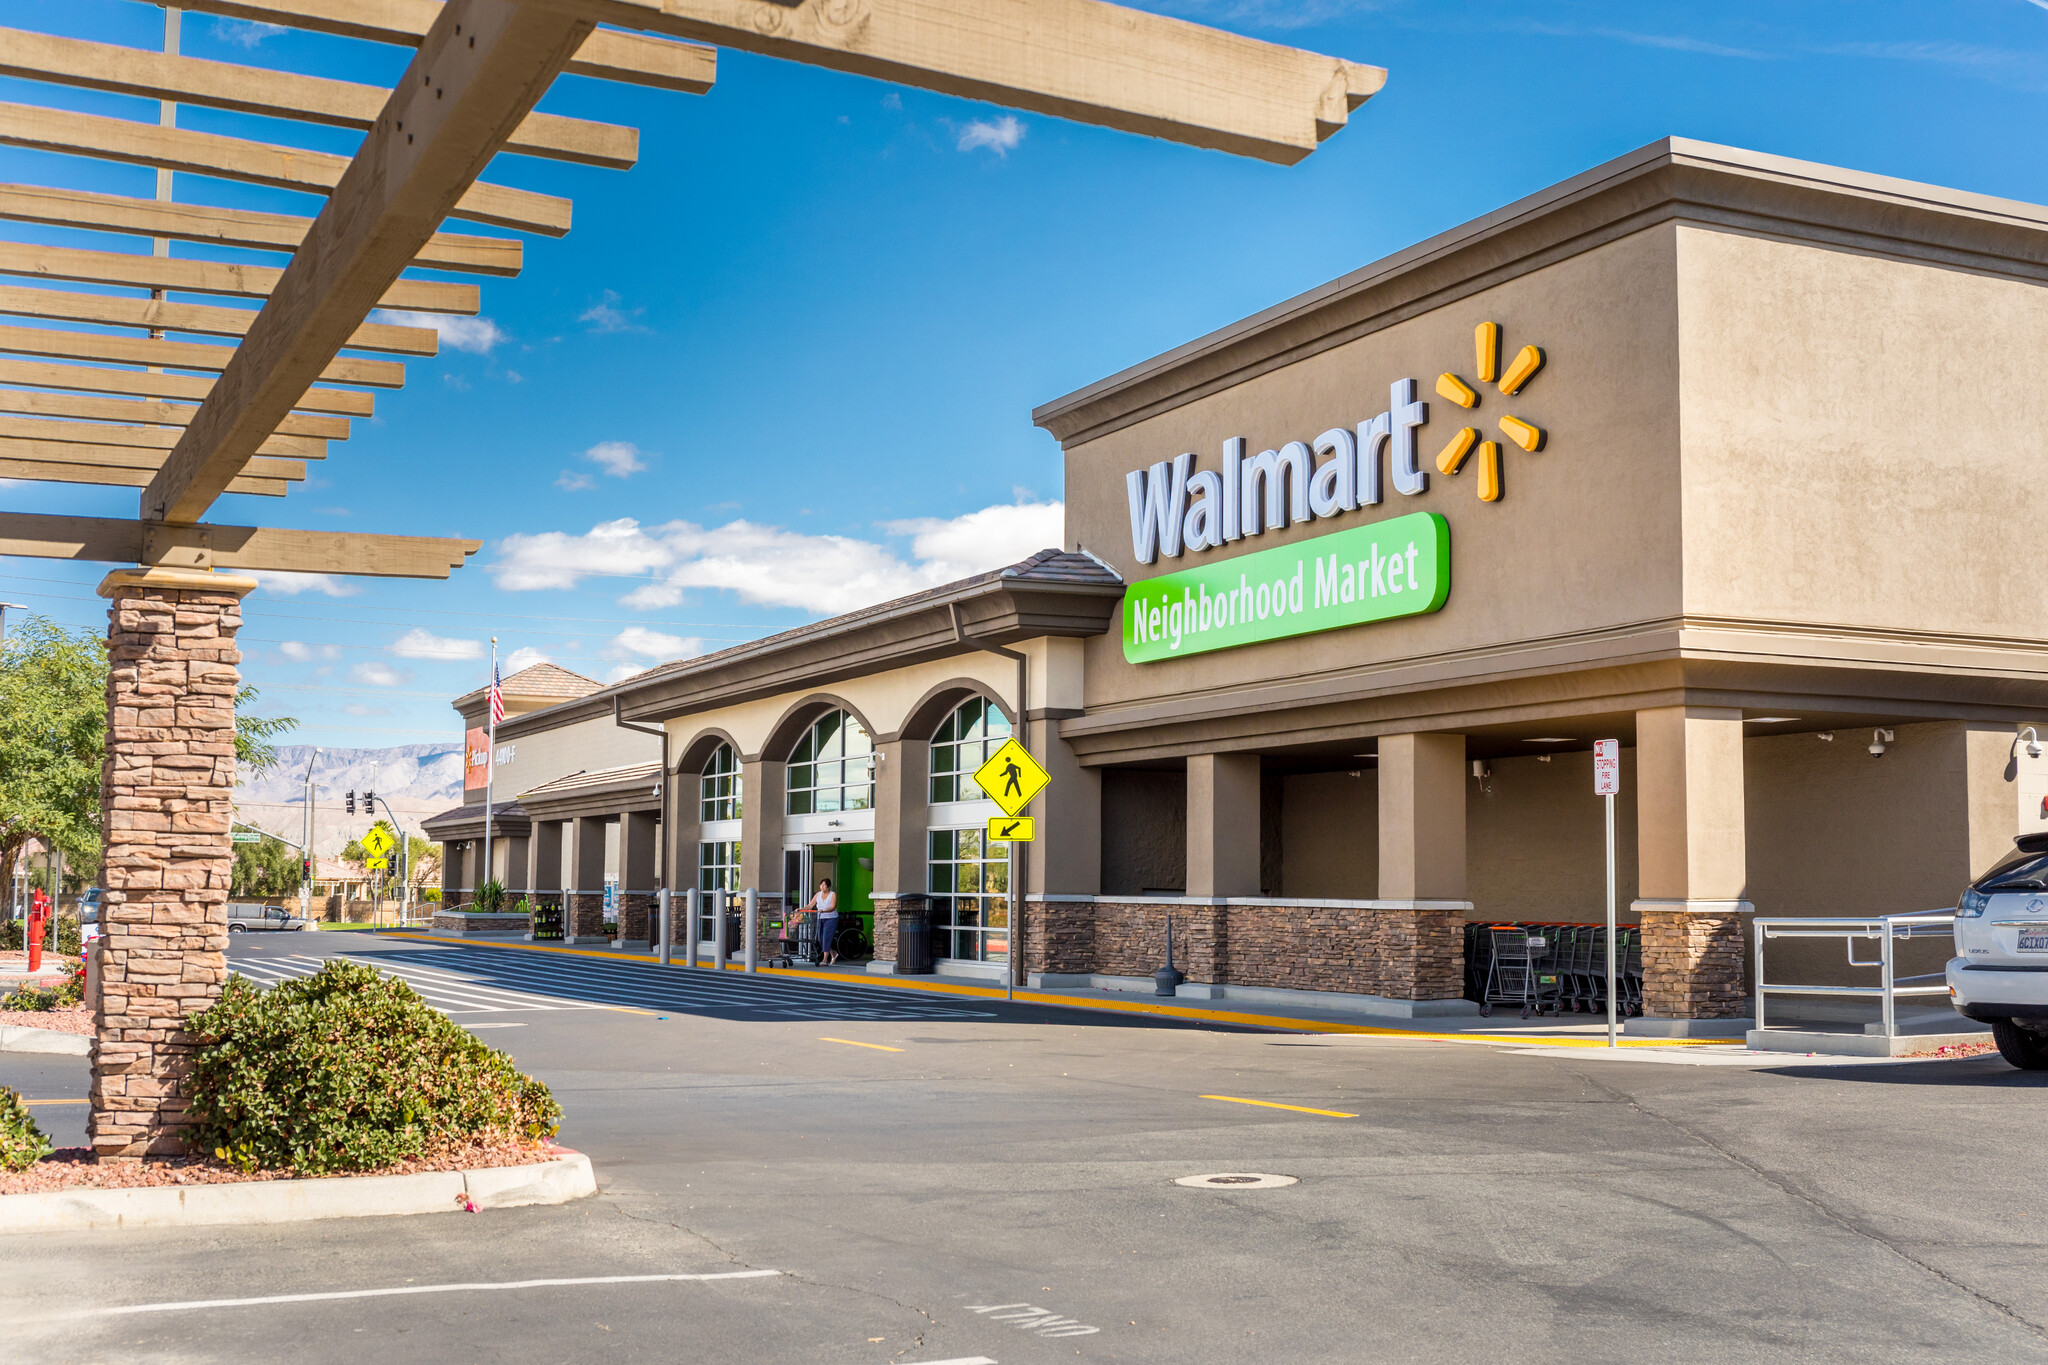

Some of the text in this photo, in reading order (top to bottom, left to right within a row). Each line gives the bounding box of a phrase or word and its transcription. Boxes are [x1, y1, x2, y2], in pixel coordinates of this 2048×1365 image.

[1126, 377, 1428, 565] Walmart
[1133, 540, 1419, 650] Neighborhood Market
[1596, 758, 1616, 769] STOPPING
[1600, 782, 1611, 790] LANE
